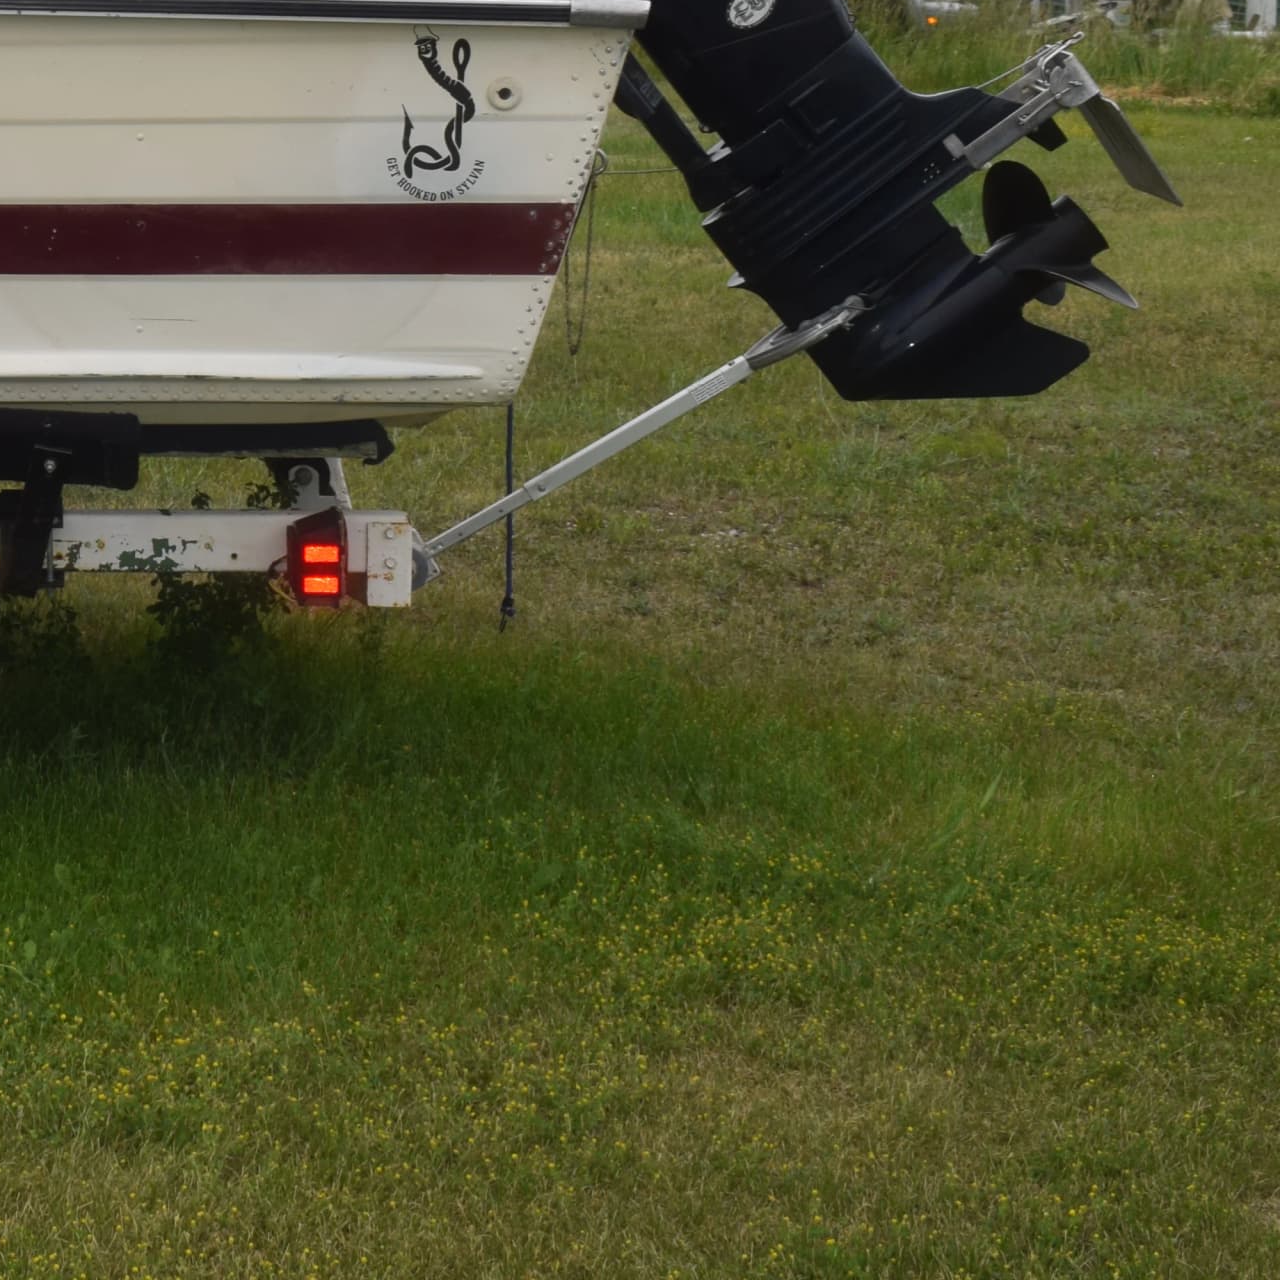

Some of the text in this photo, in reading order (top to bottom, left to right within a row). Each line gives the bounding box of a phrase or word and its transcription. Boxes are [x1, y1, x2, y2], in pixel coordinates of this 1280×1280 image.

[386, 157, 485, 202] GET HOOKED ON SYLVAN
